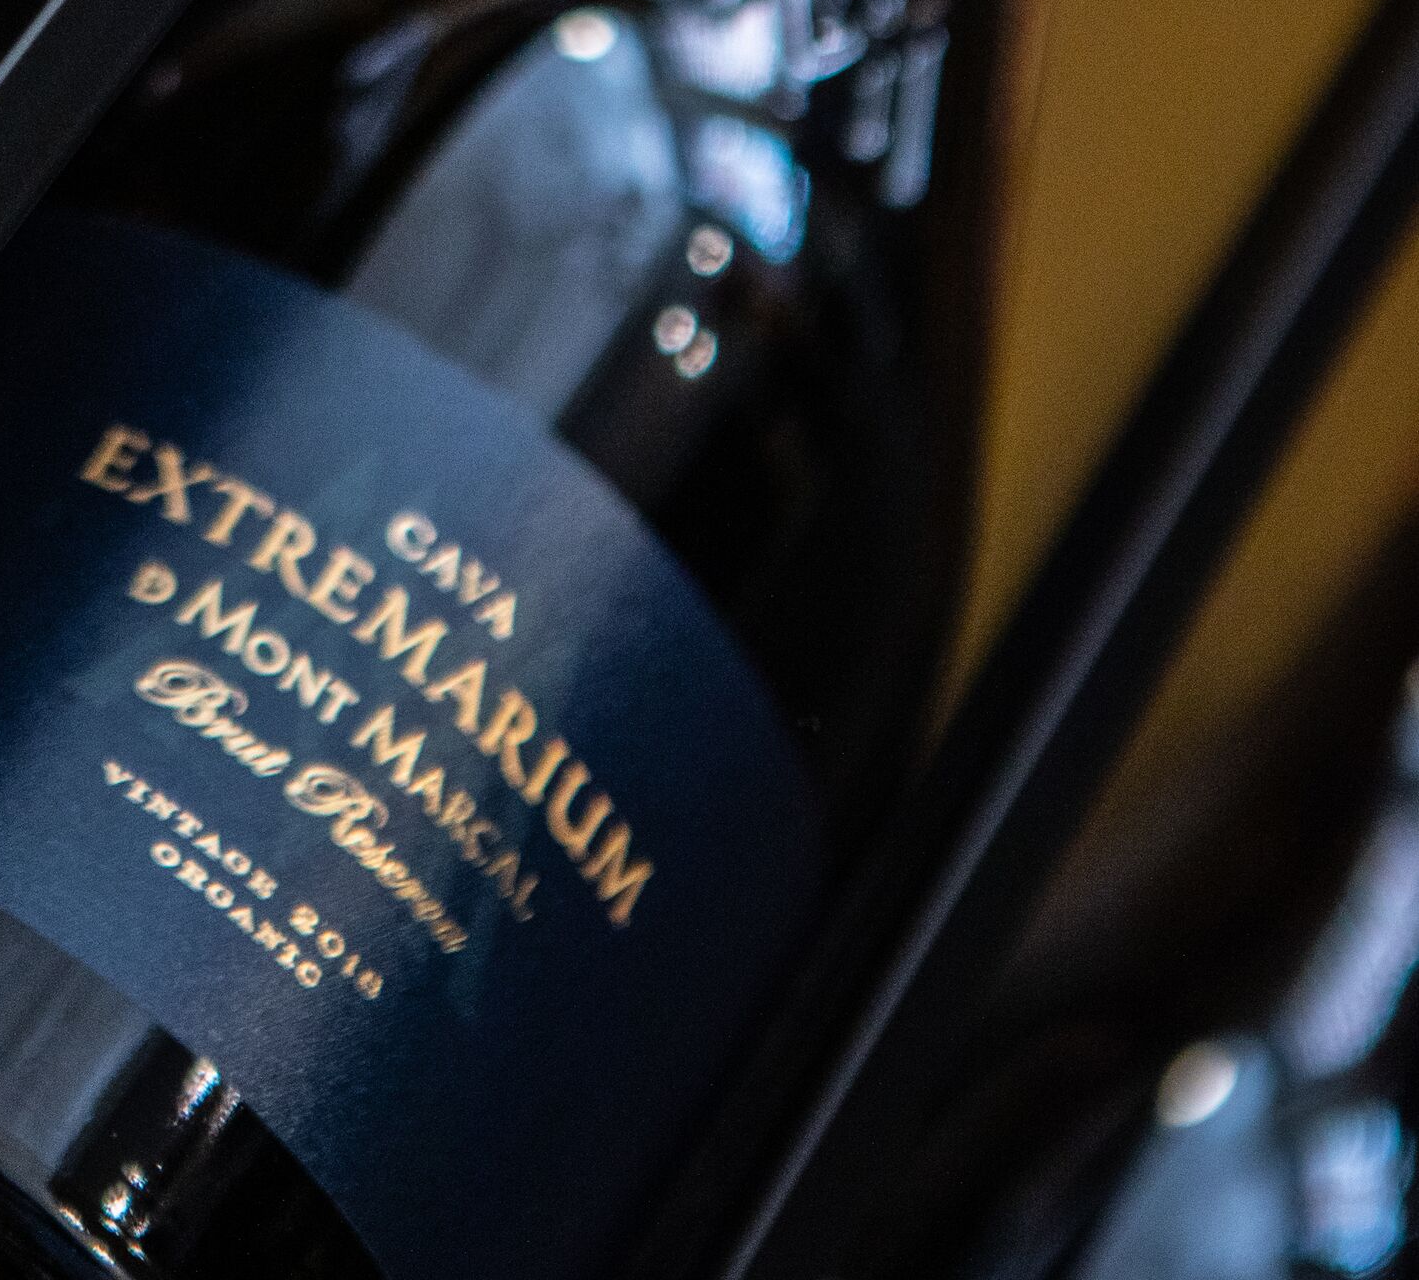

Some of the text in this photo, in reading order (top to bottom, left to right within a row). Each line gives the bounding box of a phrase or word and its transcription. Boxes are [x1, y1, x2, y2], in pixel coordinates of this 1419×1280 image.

[385, 511, 517, 641] CAVA
[80, 424, 656, 930] EXTREMARIUM
[174, 580, 360, 724] MONT
